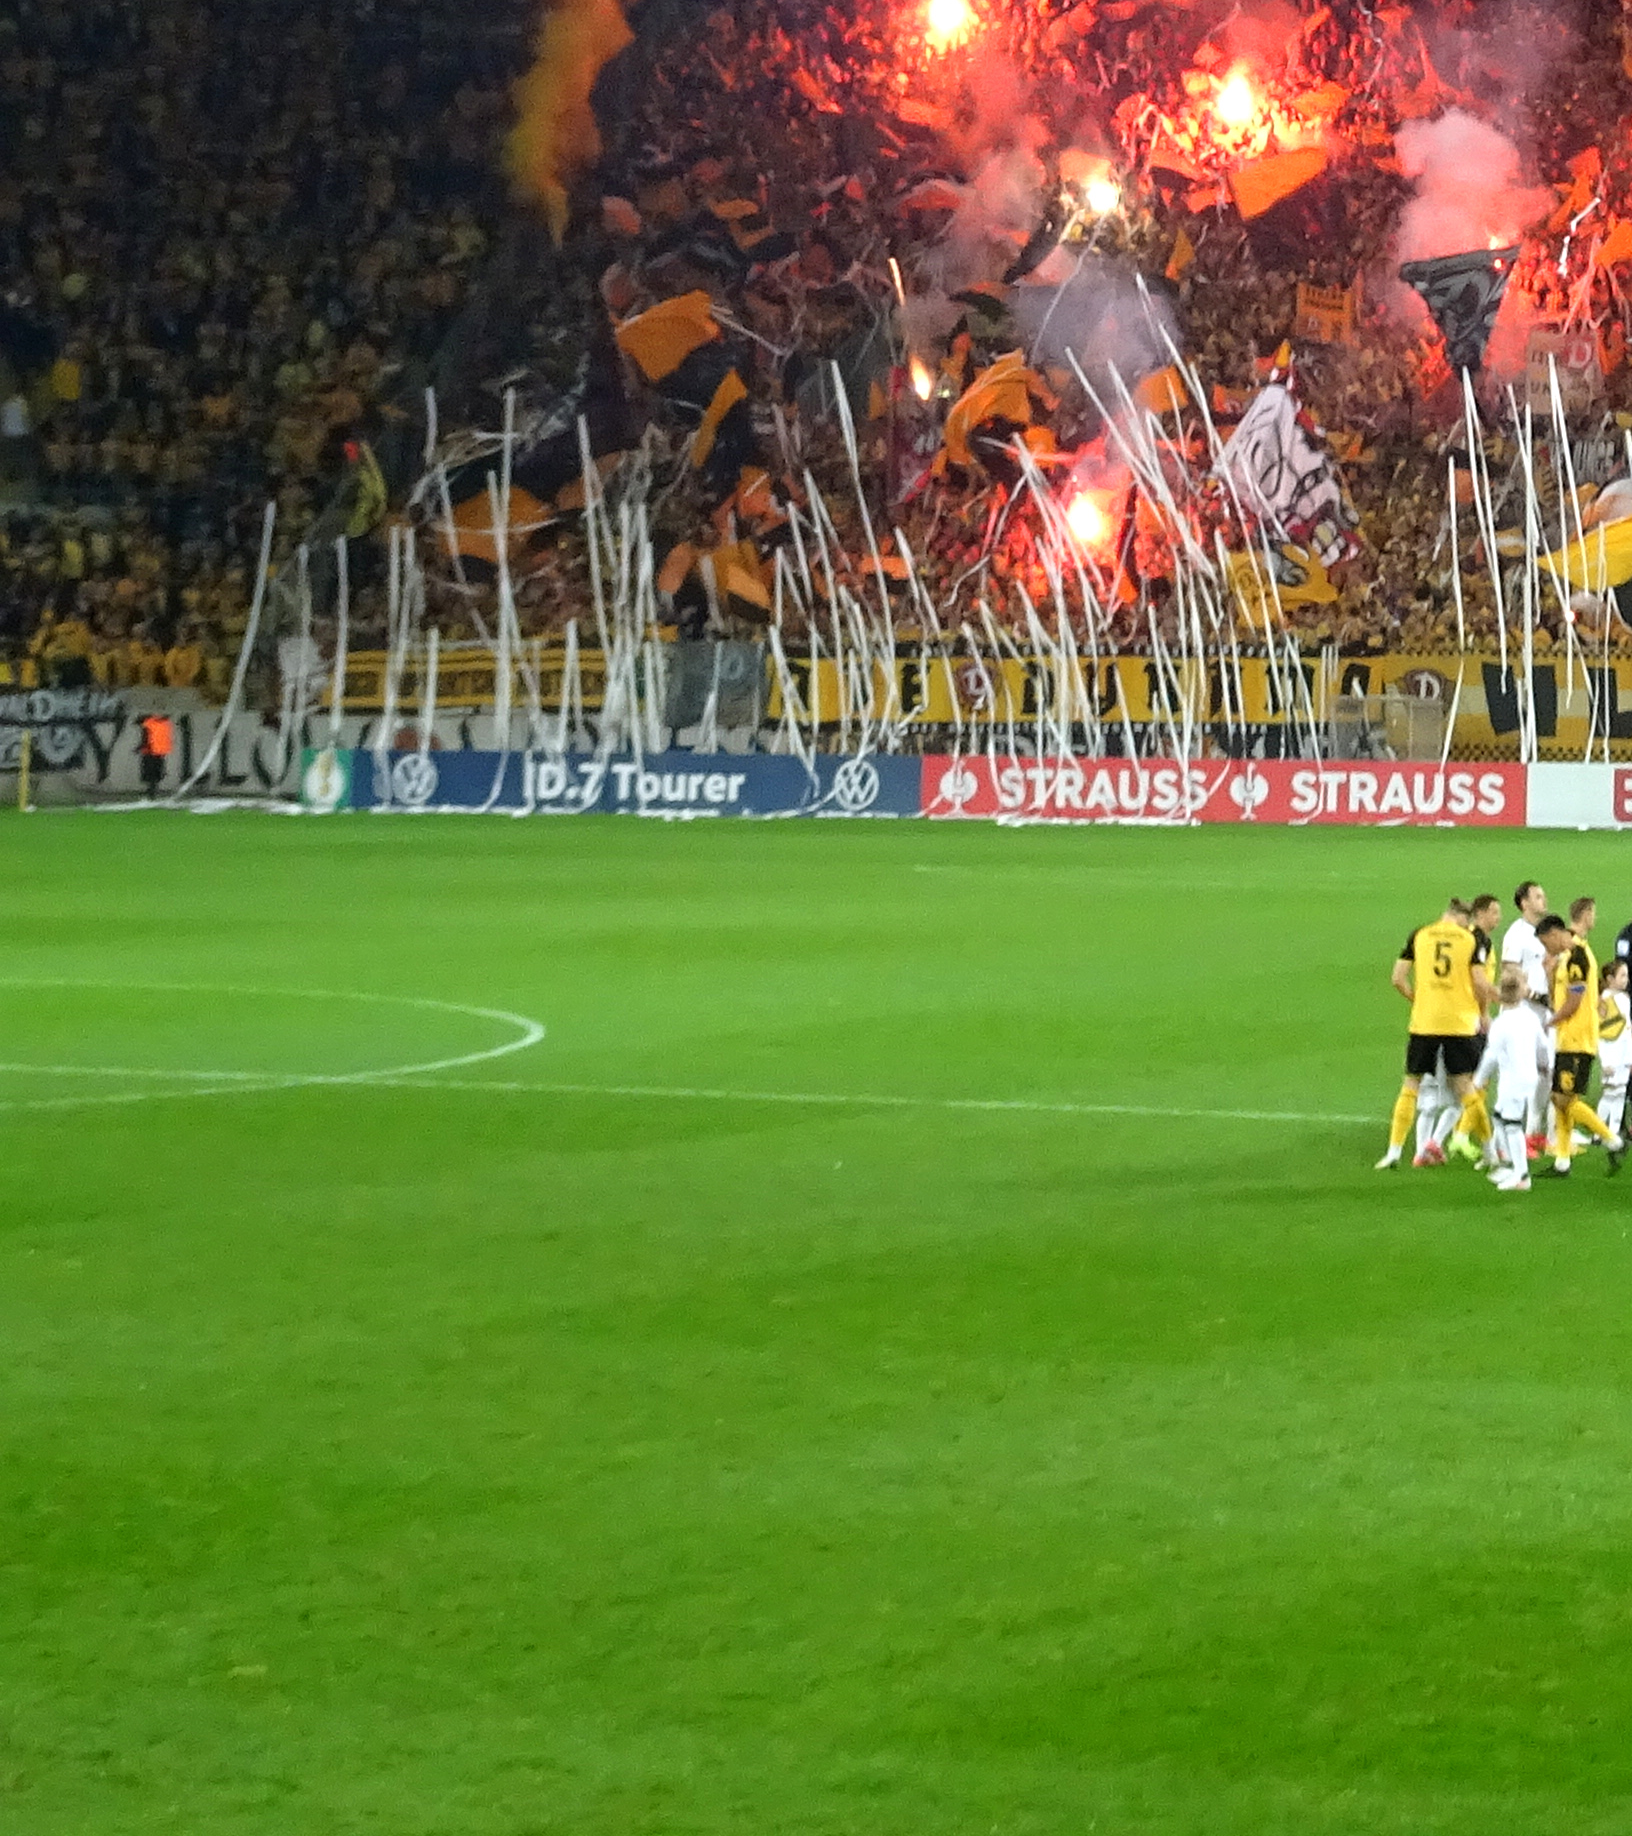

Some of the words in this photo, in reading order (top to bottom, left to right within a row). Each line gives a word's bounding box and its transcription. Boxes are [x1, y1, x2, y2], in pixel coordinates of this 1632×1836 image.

[612, 763, 745, 802] Tourer
[1000, 768, 1206, 812] STRAUSS
[1290, 771, 1505, 816] STRAUSS
[1433, 940, 1452, 978] 5
